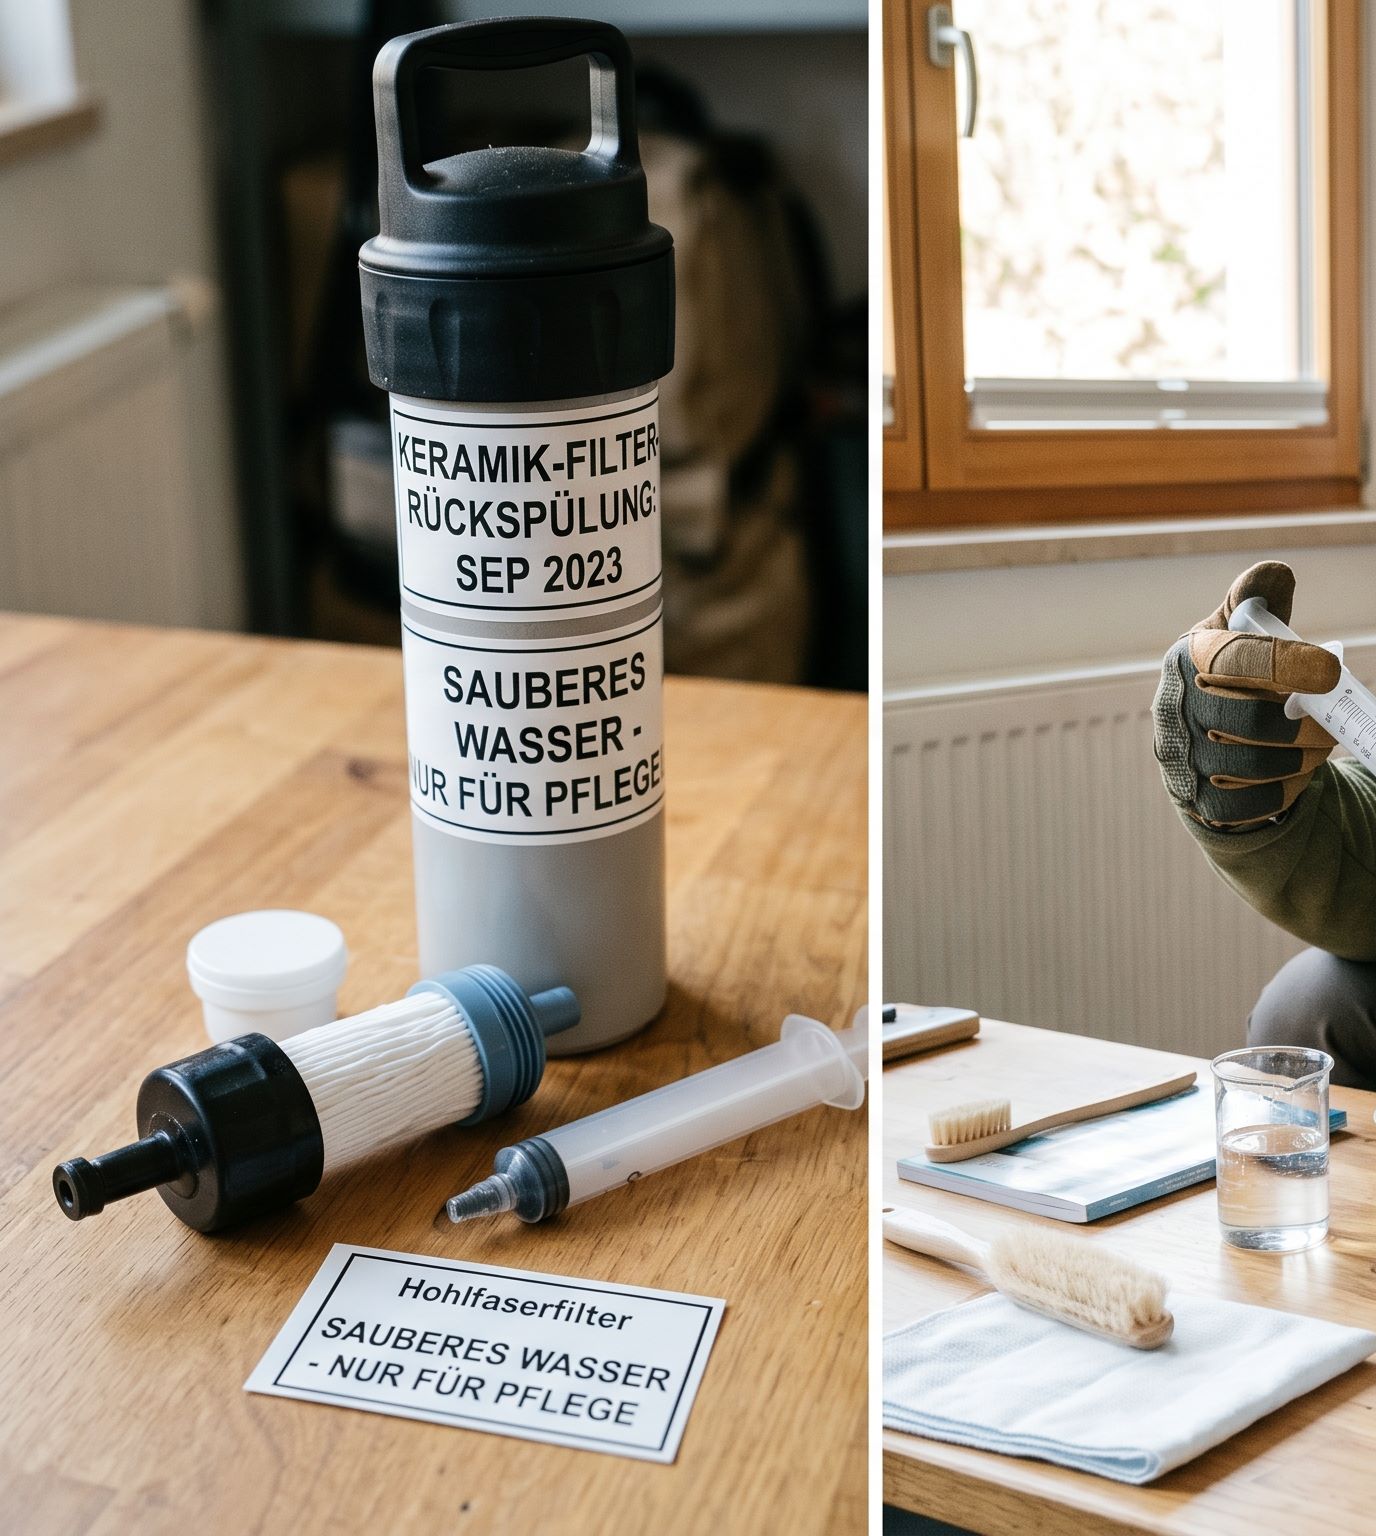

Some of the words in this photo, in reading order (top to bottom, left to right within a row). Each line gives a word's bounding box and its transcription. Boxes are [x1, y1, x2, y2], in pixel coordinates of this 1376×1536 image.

[398, 422, 659, 483] KERAMIK-FILTER-
[407, 480, 656, 539] RÜCKSPÜLUNG:
[456, 554, 530, 594] SEP
[543, 546, 623, 593] 2023
[443, 651, 645, 710] SAUBERES
[454, 715, 624, 764] WASSER
[459, 771, 532, 817] FÜR
[398, 1277, 633, 1330] Hohlfaserfilter
[321, 1317, 510, 1365] SAUBERES
[521, 1347, 671, 1391] WASSER
[328, 1355, 405, 1387] NUR
[412, 1365, 485, 1400] FÜR
[494, 1382, 640, 1425] PFLEGE
